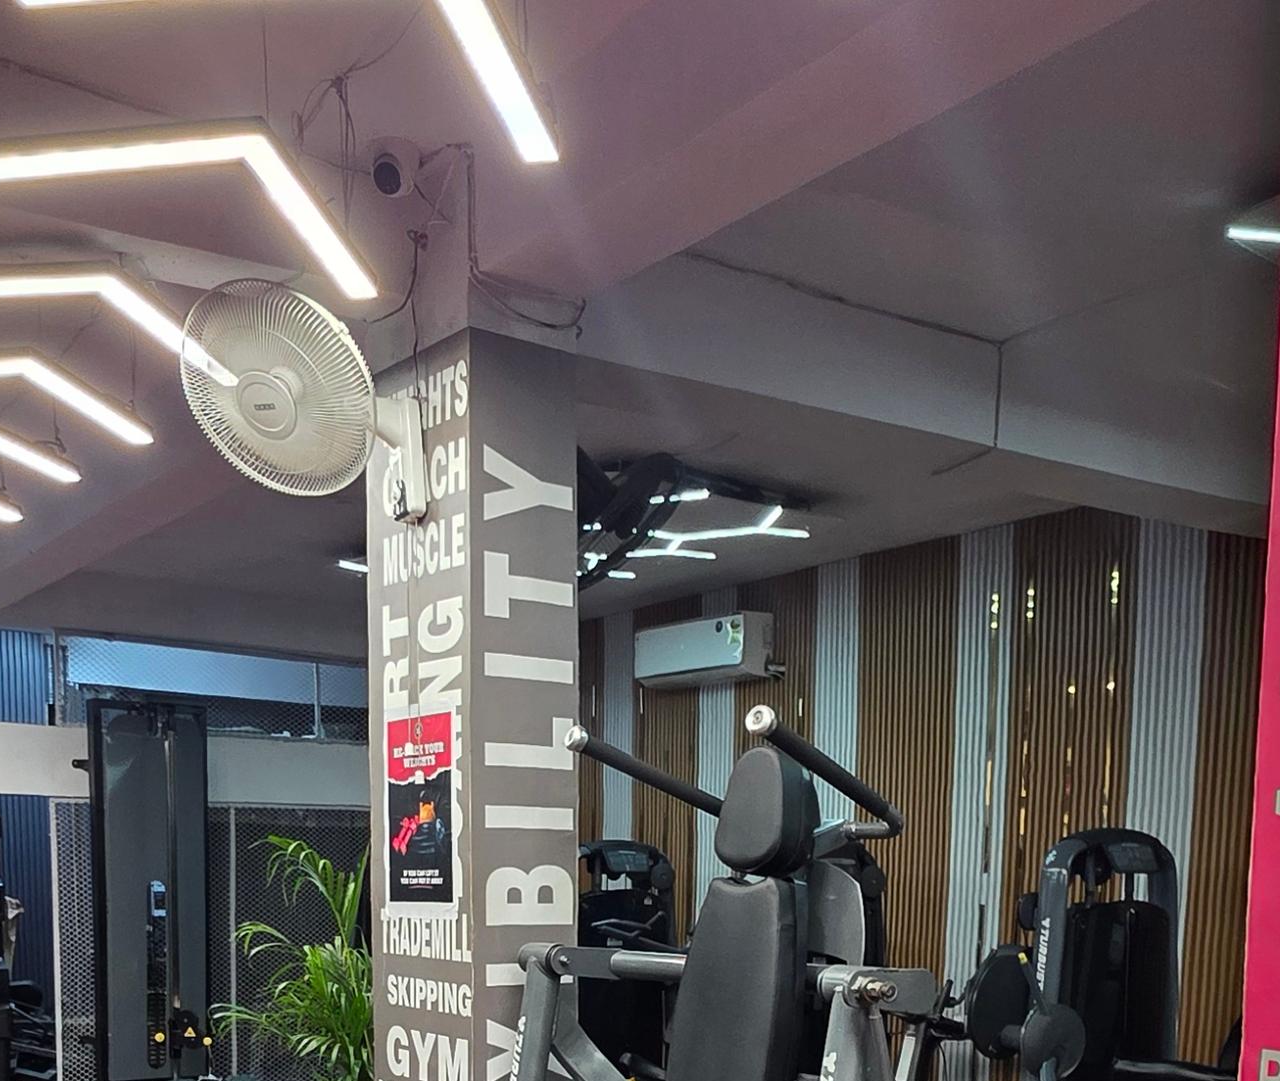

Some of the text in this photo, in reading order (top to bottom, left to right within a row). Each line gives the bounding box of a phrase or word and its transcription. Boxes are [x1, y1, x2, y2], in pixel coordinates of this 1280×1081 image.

[387, 359, 468, 432] GHTS
[383, 436, 467, 518] CCH
[382, 512, 466, 588] MUSCLE
[380, 907, 473, 963] TRADEMILL
[1036, 927, 1050, 992] TURBUST
[386, 973, 473, 1018] SKIPPING
